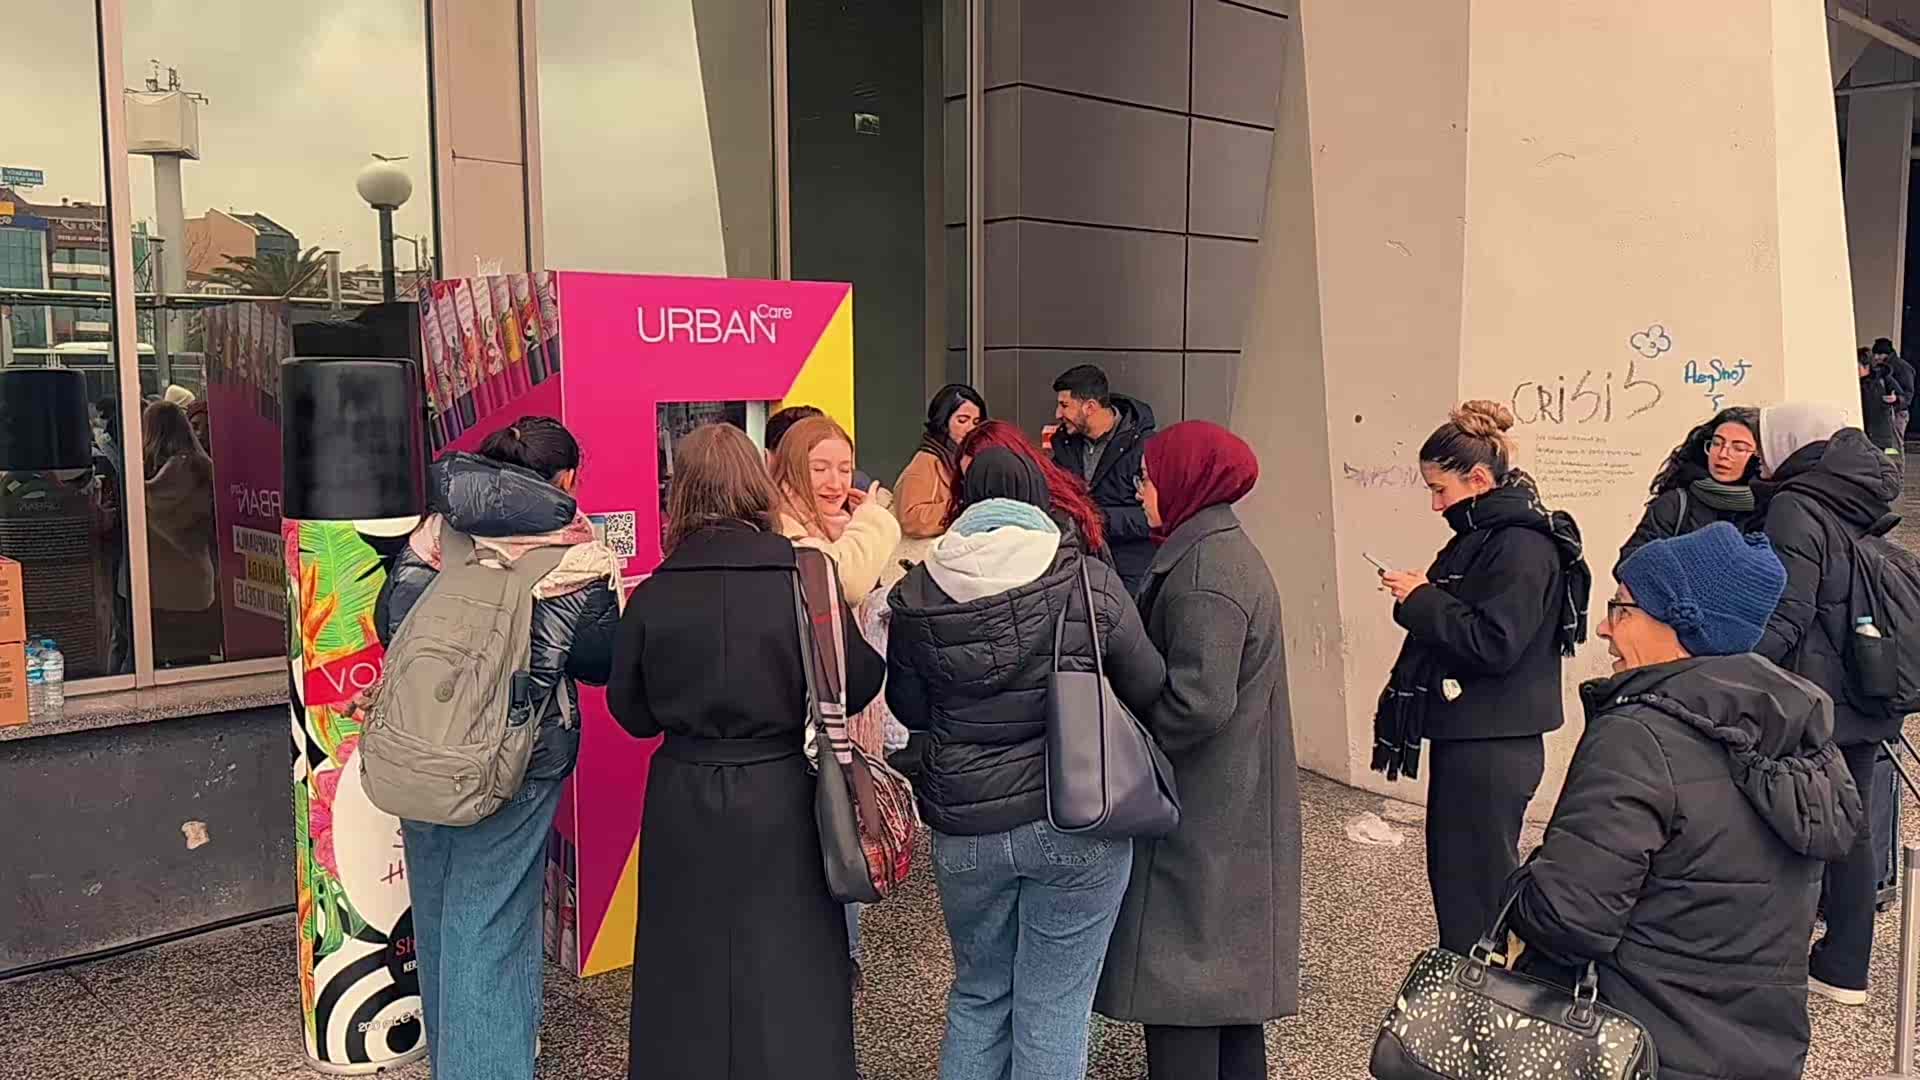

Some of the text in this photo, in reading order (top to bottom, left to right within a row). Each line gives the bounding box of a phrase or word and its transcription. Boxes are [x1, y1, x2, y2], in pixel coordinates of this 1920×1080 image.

[637, 303, 793, 345] URBAN Care
[403, 960, 418, 972] KER
